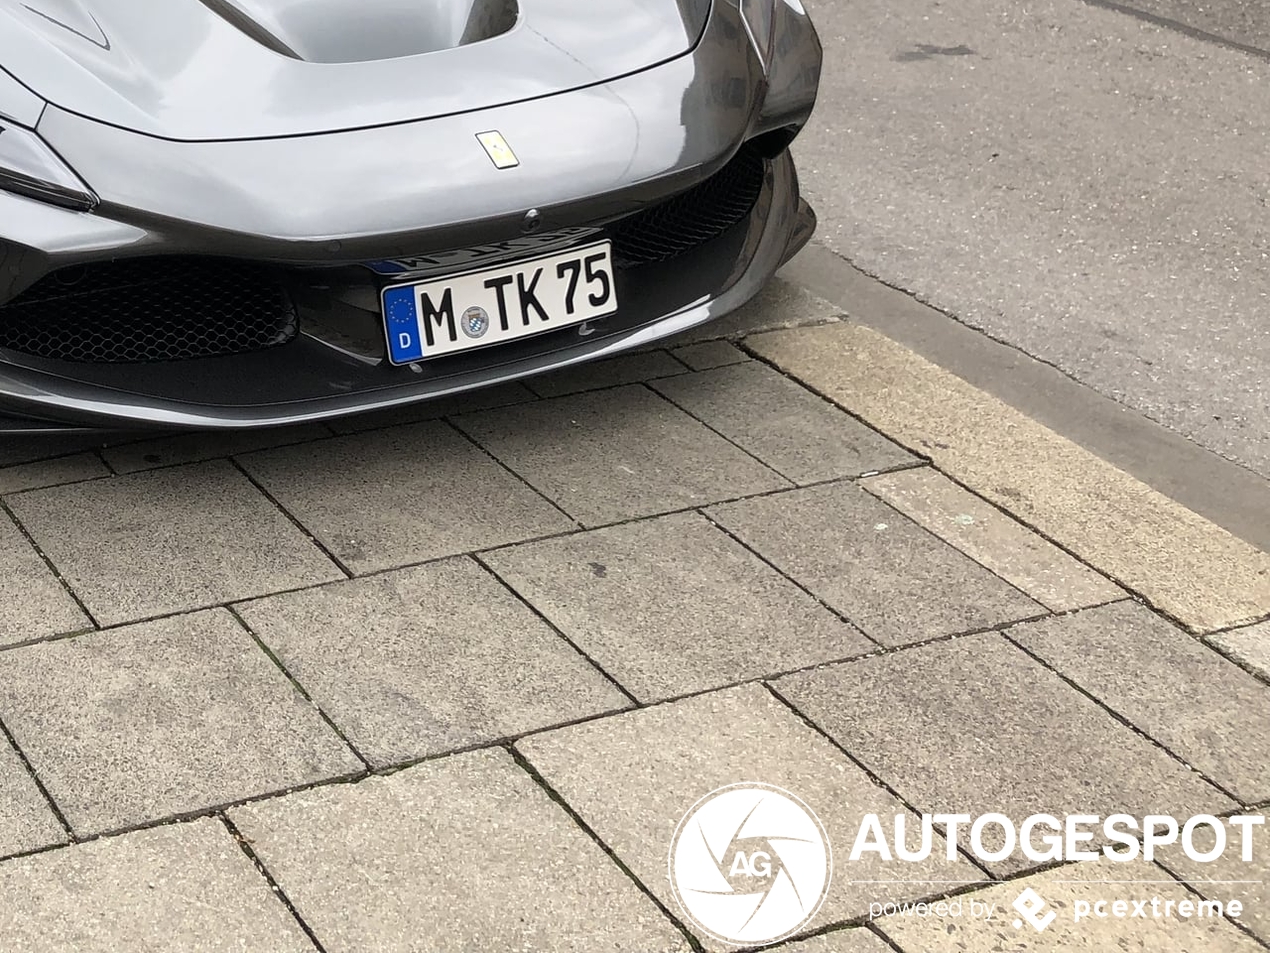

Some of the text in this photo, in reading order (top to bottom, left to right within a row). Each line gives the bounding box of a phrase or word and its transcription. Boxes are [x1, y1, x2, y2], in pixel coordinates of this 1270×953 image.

[420, 287, 458, 347] M
[484, 267, 550, 331] TK
[556, 251, 611, 315] 75
[399, 332, 411, 349] D
